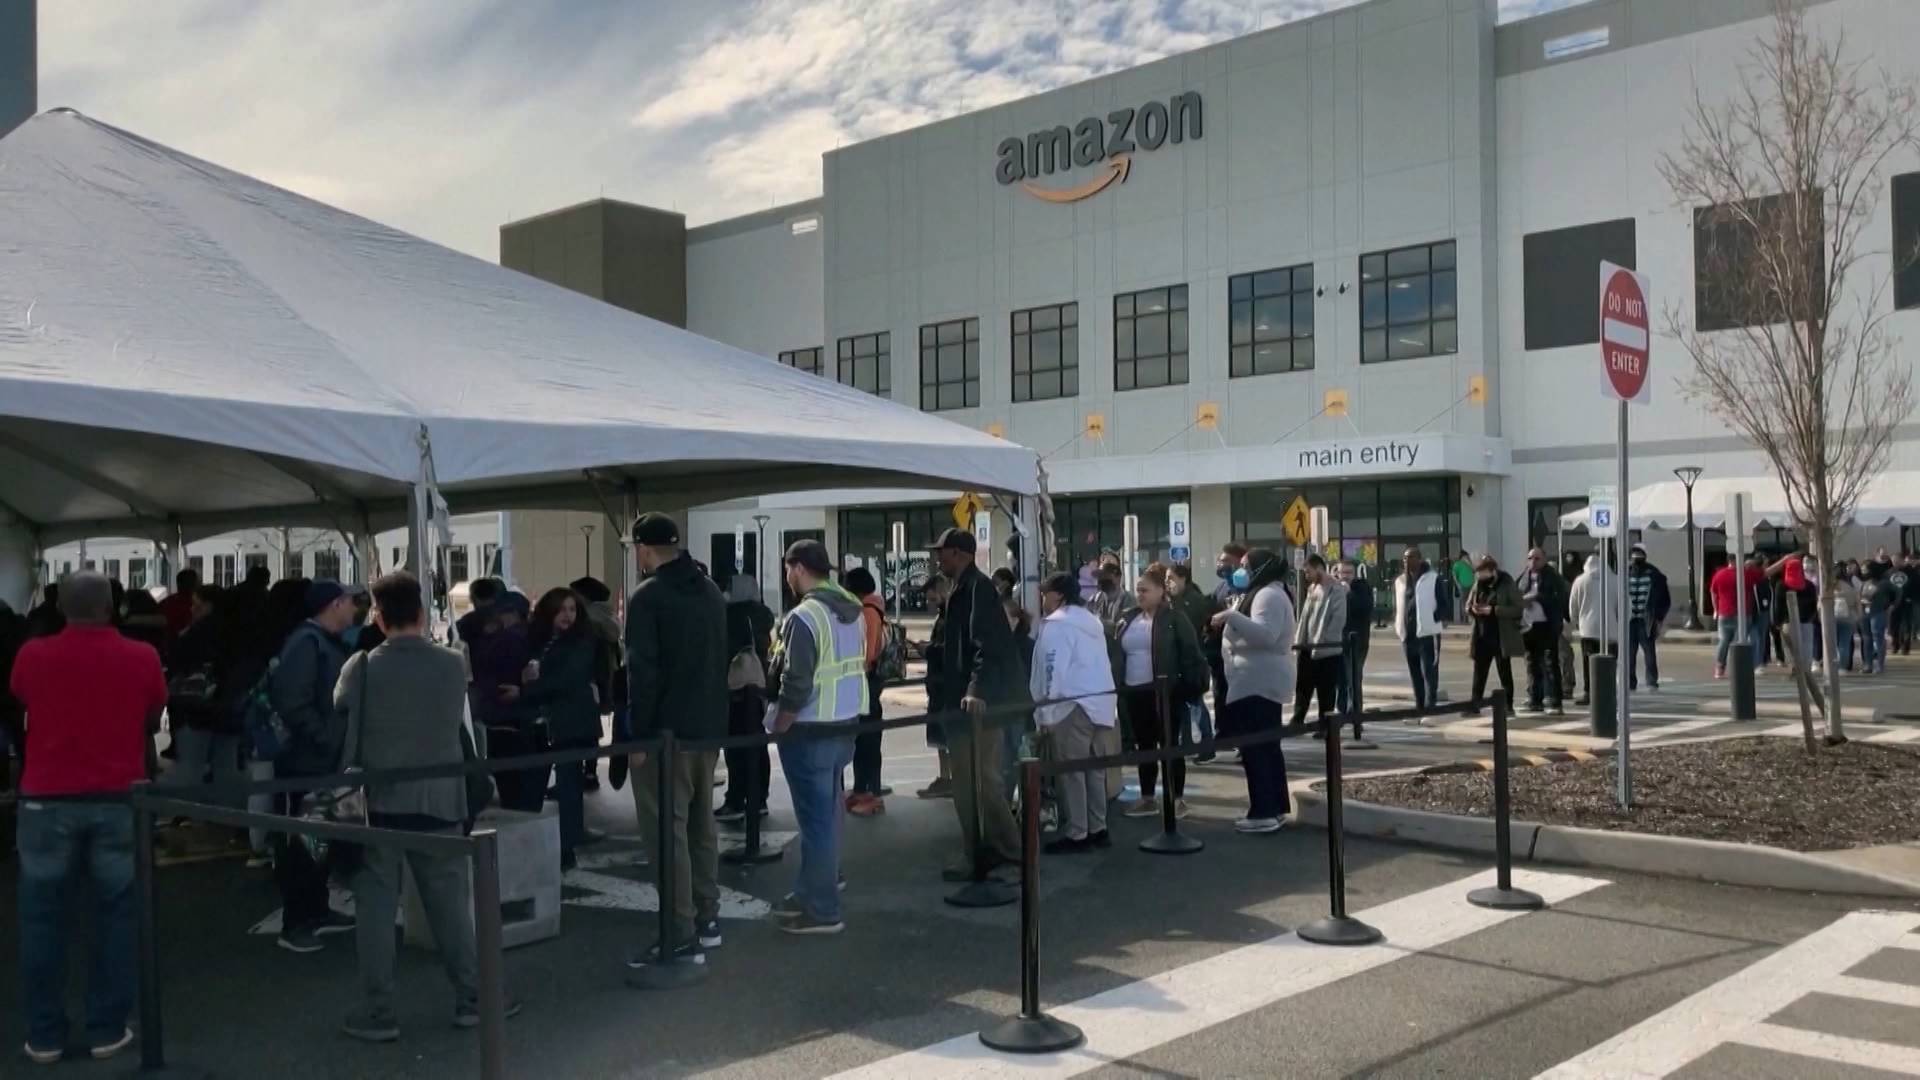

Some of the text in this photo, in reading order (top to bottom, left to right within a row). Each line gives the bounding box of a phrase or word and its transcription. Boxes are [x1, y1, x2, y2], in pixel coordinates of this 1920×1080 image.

[996, 91, 1203, 185] amazon
[1608, 291, 1642, 318] DO NOT
[1611, 351, 1640, 376] ENTER
[1299, 440, 1419, 467] main entry
